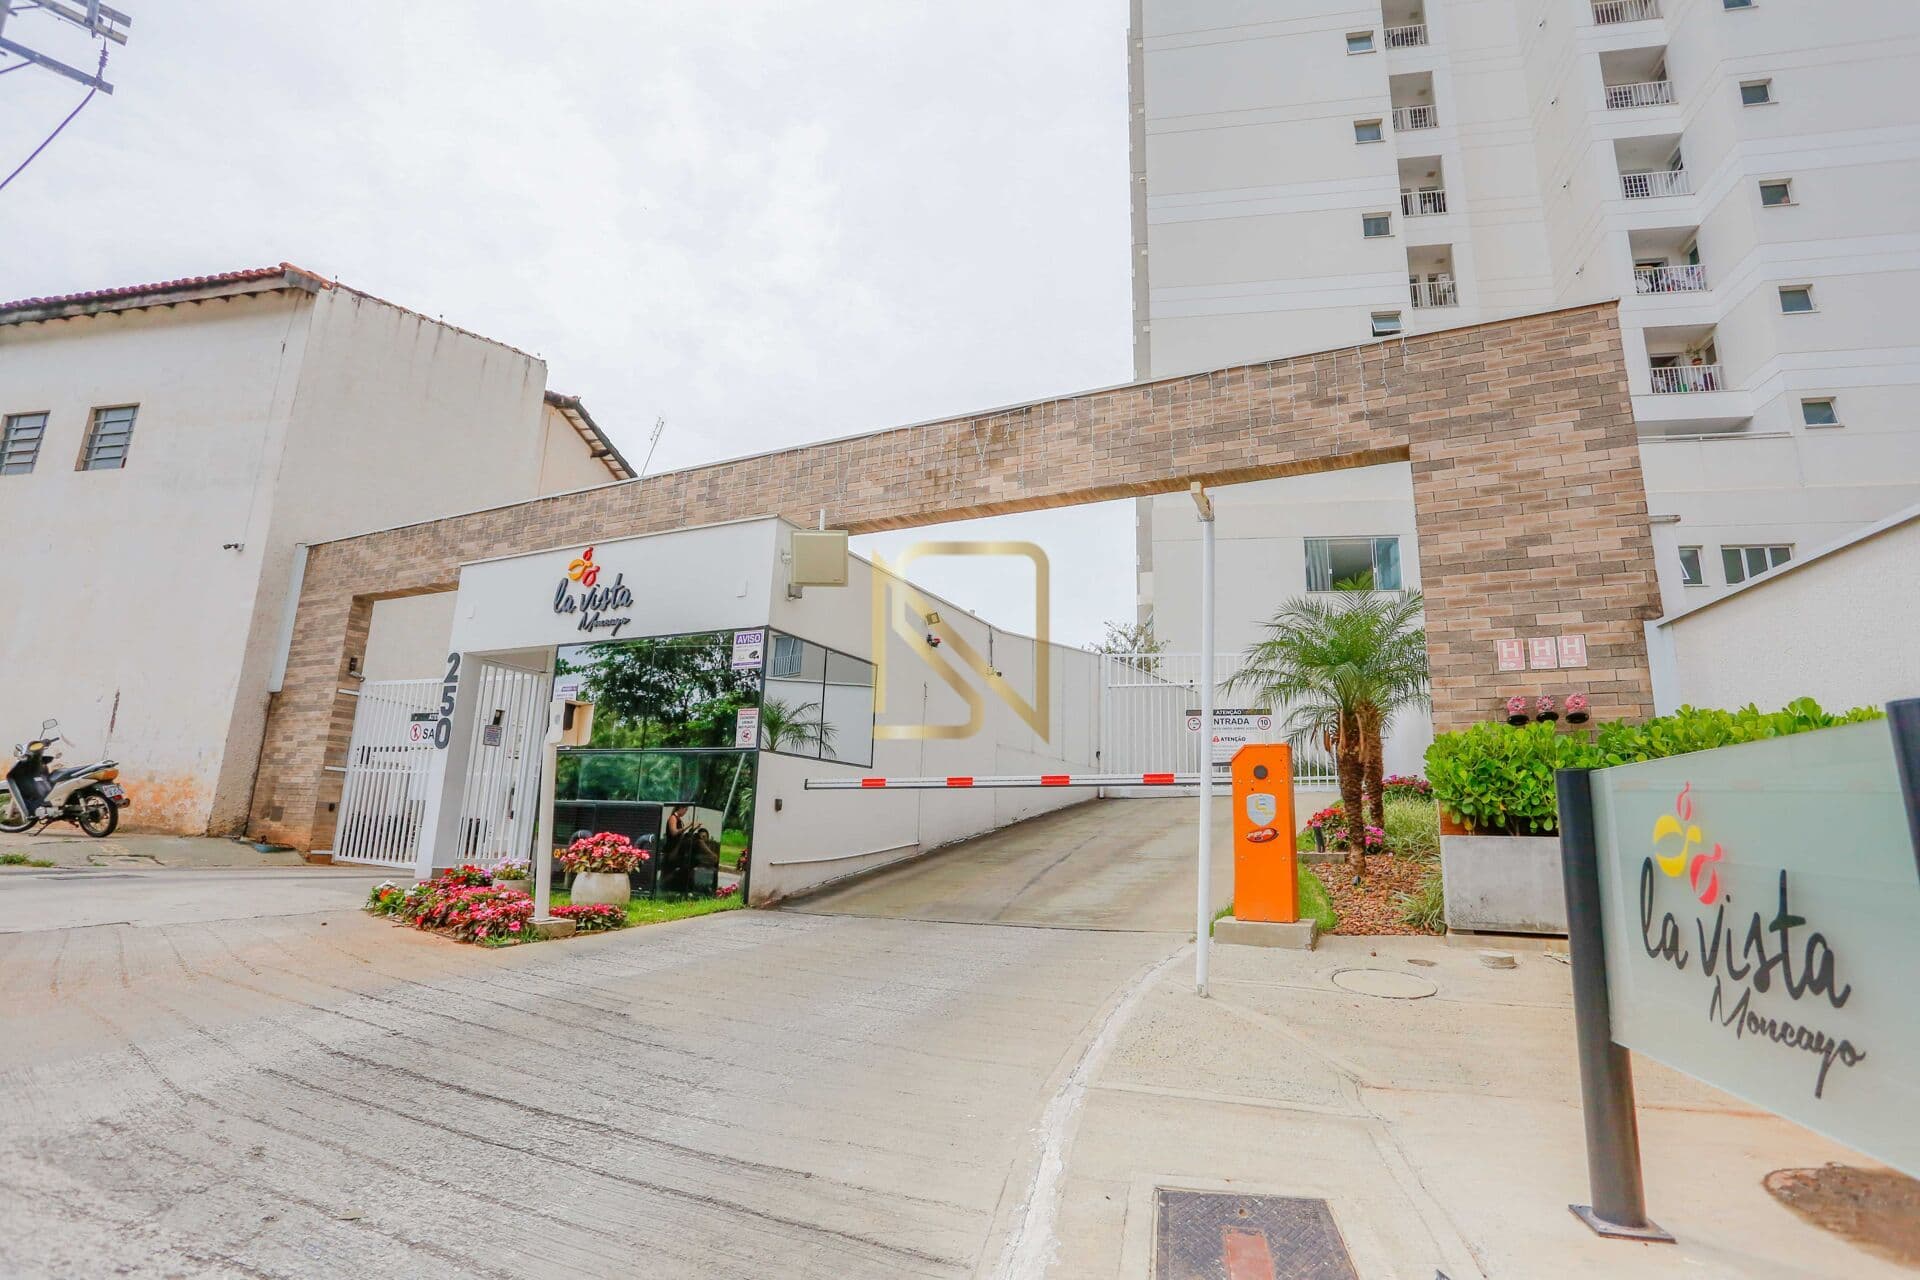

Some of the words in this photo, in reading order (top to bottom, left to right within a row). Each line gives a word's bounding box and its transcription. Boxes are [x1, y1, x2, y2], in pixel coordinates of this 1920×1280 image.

[553, 577, 577, 613] la
[579, 573, 634, 612] vista
[737, 633, 761, 644] AVISO
[434, 652, 461, 750] 250
[1213, 717, 1250, 726] NTRADA
[1640, 857, 1688, 970] la
[1697, 869, 1851, 1008] vista
[1710, 975, 1866, 1099] Moncayo
